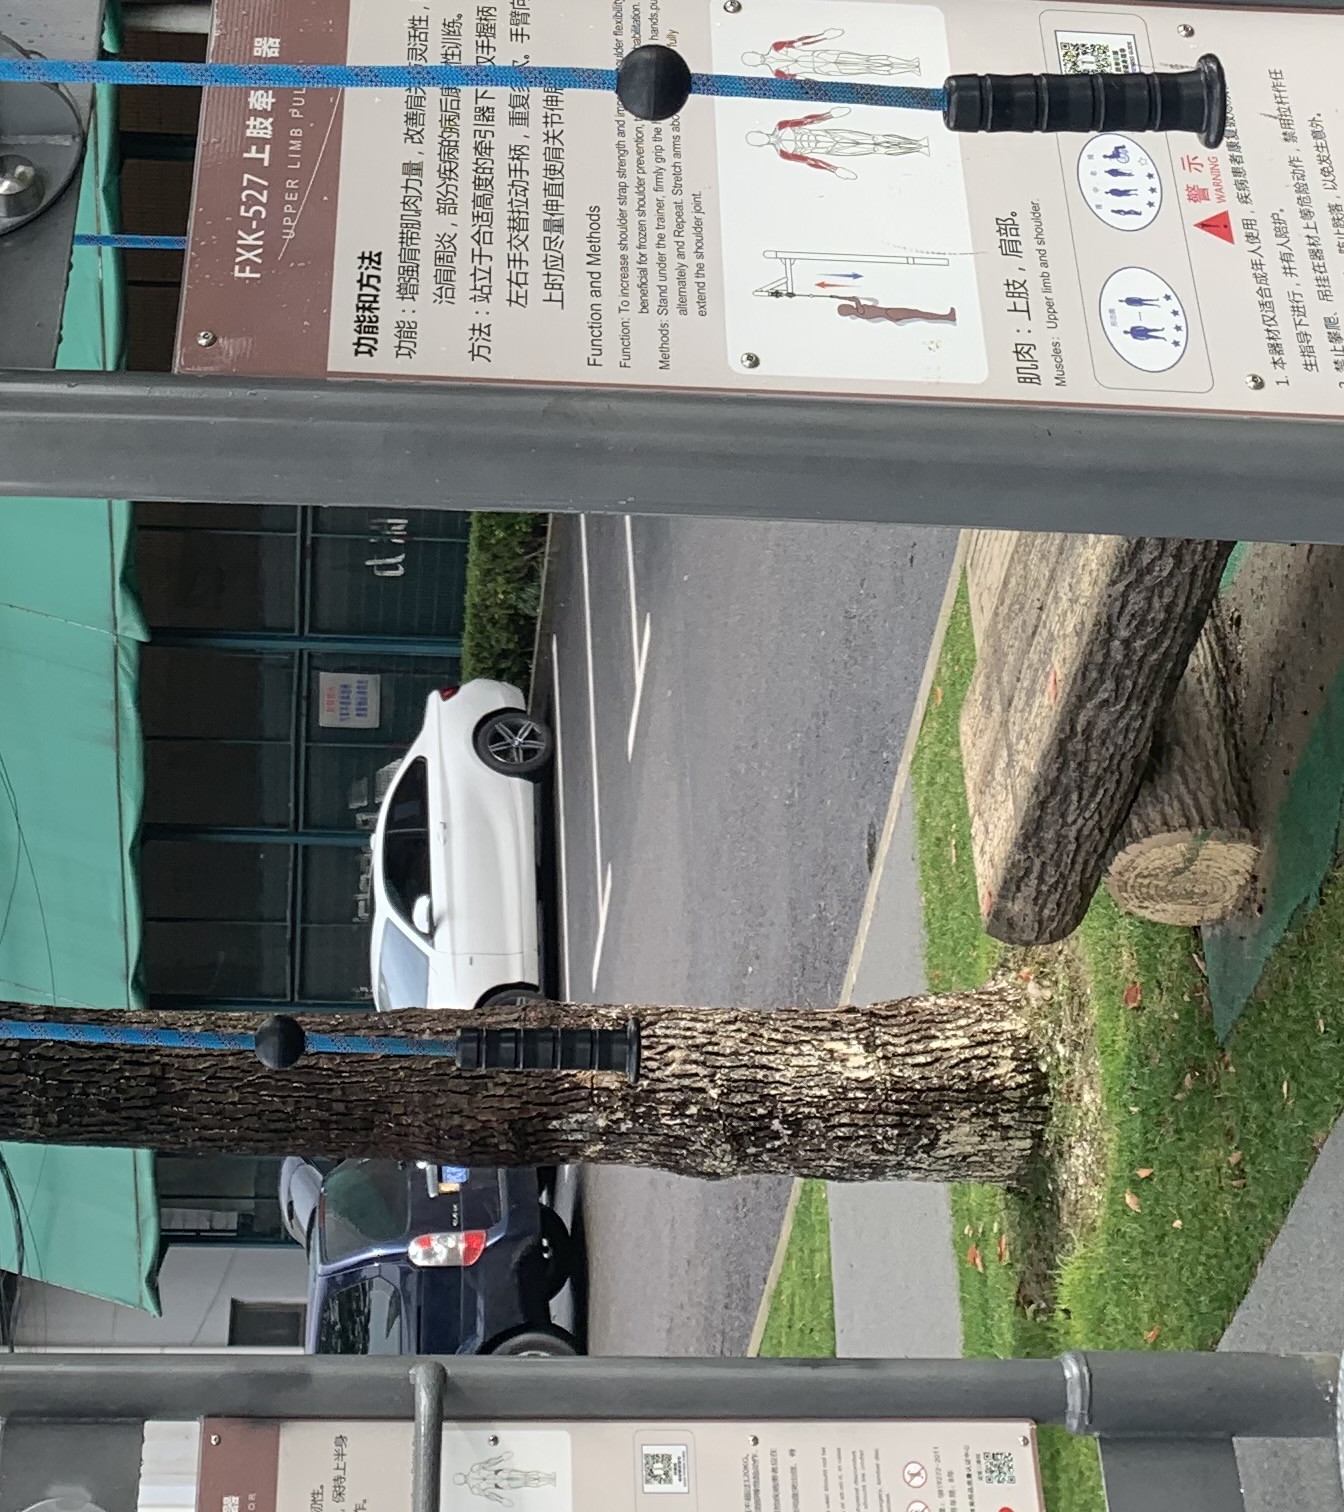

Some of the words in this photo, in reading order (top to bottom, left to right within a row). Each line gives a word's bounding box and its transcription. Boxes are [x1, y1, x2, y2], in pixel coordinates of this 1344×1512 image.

[242, 37, 280, 167] 上肢牵器
[288, 87, 305, 118] PUL
[614, 119, 626, 139] and
[651, 127, 662, 143] the
[669, 113, 681, 133] abo
[287, 128, 302, 169] LIMB
[432, 14, 463, 305] 治肩周炎，部分疾病的病后康性训练。
[614, 140, 629, 180] strength
[651, 145, 666, 164] grip
[671, 135, 681, 160] arms
[616, 181, 629, 207] strap
[652, 166, 666, 193] firmly
[670, 161, 683, 197] Stretch
[1206, 156, 1226, 204] WARNING
[280, 179, 299, 239] UPPER
[634, 176, 646, 218] shoulder
[690, 191, 705, 215] joint.
[233, 174, 268, 280] FXK-527
[585, 206, 601, 266] Methods
[616, 208, 628, 252] shoulder
[635, 220, 647, 250] frozen
[691, 216, 704, 260] shoulder
[1029, 200, 1045, 246] shoulder.
[654, 233, 666, 250] the
[673, 240, 686, 261] and
[635, 252, 648, 266] for
[655, 251, 667, 282] under
[693, 263, 705, 279] the
[1034, 249, 1049, 269] and
[585, 271, 602, 299] and
[617, 254, 629, 298] increase
[635, 267, 649, 314] beneficial
[674, 262, 689, 317] alternately
[1038, 271, 1052, 294] limb
[351, 251, 382, 358] 功能和方法
[617, 300, 630, 315] To
[655, 285, 668, 317] Stand
[693, 281, 707, 317] extend
[994, 211, 1042, 386] 肌肉：上肢，肩部。
[1044, 296, 1059, 330] Upper
[586, 303, 602, 367] Function
[1274, 376, 1289, 386] 1.
